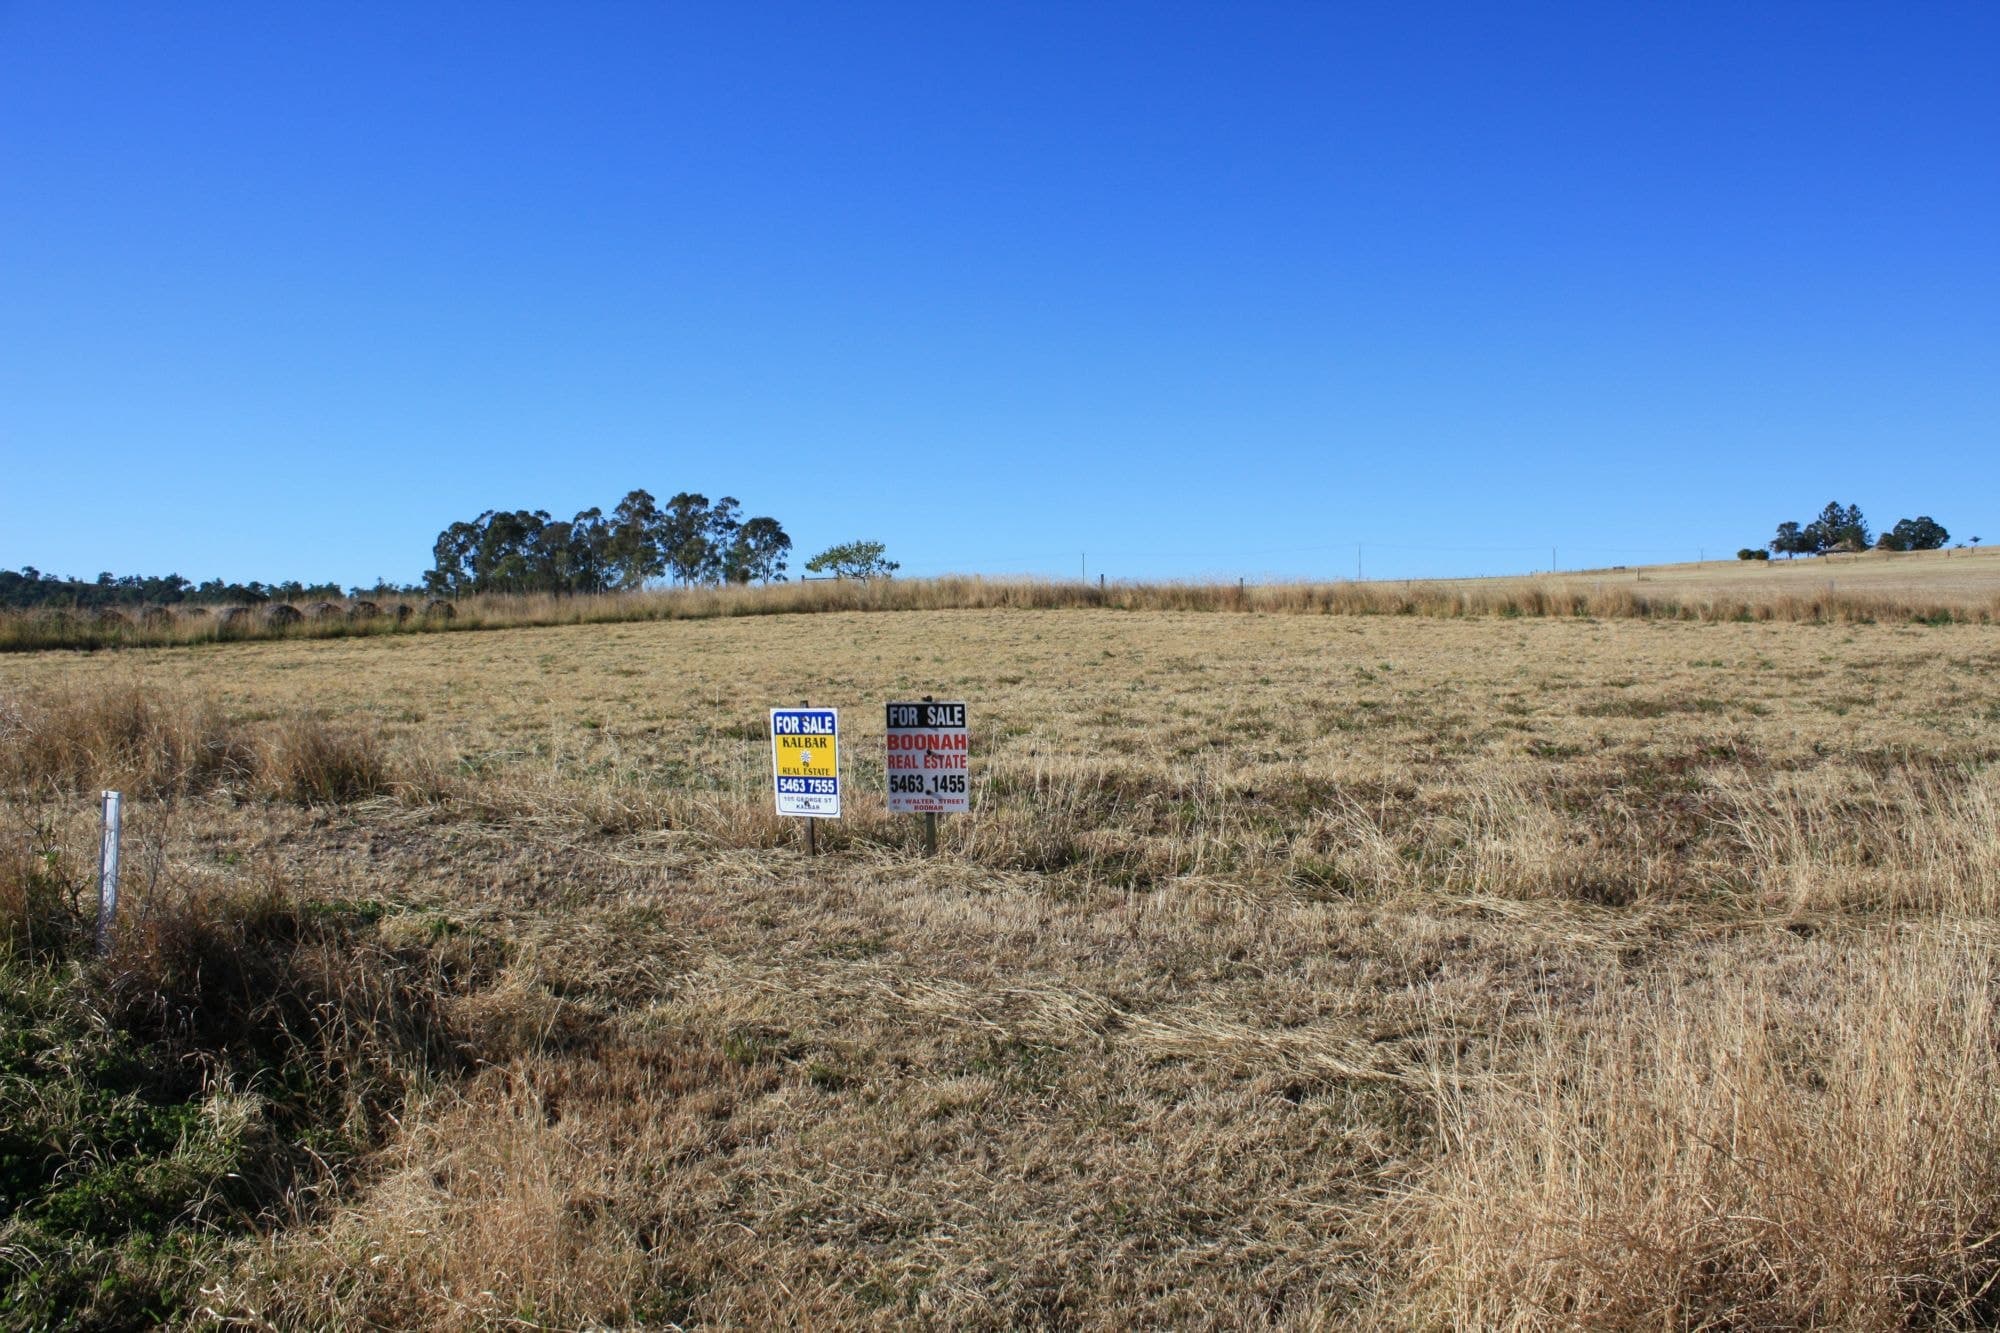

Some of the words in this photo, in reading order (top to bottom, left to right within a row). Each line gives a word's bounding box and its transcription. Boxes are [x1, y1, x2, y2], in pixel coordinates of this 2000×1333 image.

[890, 706, 918, 726] FOR
[927, 706, 963, 726] SALE
[776, 716, 800, 733] FOR
[802, 716, 833, 733] SALE
[782, 737, 827, 748] KALBAR
[887, 734, 967, 750] BOONAH
[888, 755, 918, 769] REAL
[924, 754, 967, 769] ESTATE
[782, 767, 800, 775] REAL
[803, 768, 830, 776] ESTATE
[780, 779, 805, 792] 5463
[808, 780, 835, 793] 7555
[890, 774, 924, 793] 5463
[932, 775, 965, 793] 1455
